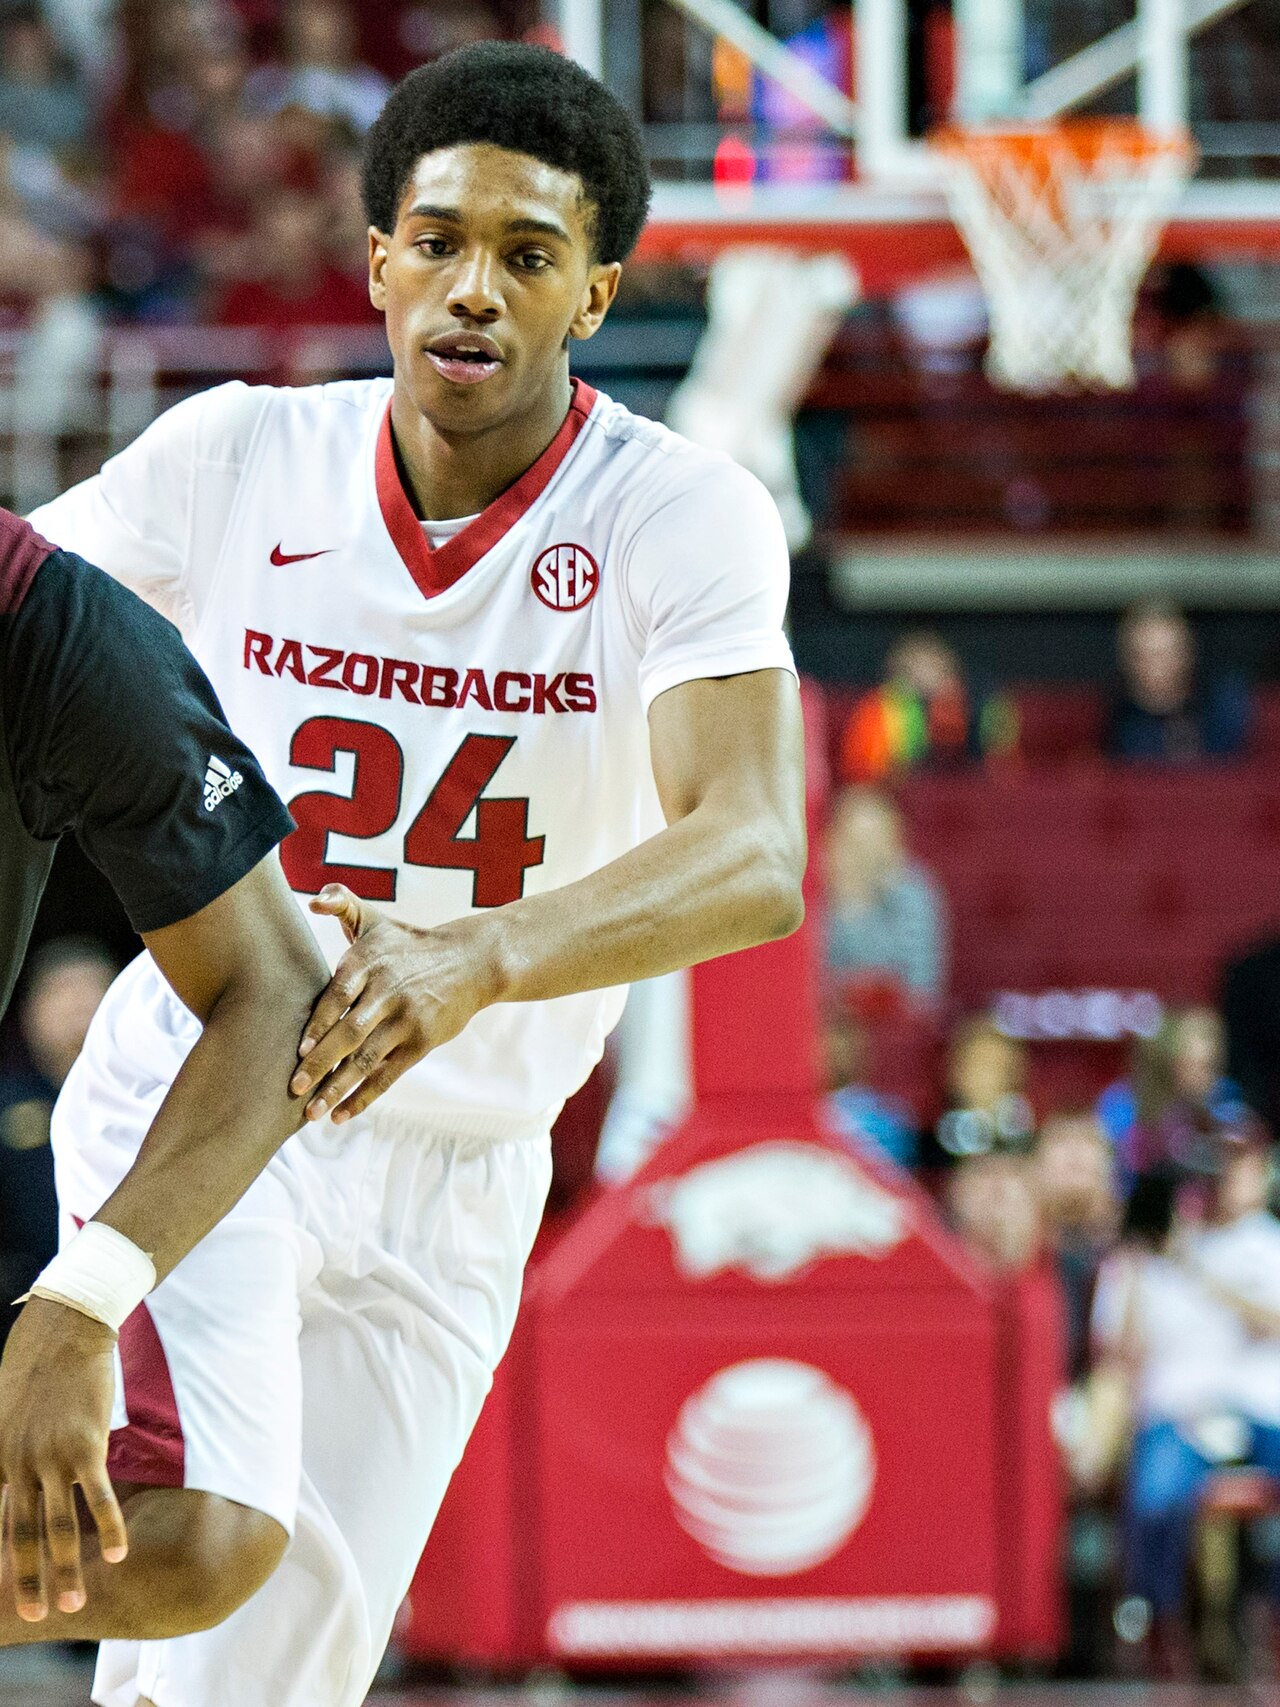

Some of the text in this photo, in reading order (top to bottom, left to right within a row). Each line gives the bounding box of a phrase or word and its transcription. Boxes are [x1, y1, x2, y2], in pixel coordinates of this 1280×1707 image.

[535, 546, 595, 608] SEC
[243, 627, 597, 715] RAZORBACKS
[204, 770, 244, 812] adidas
[278, 714, 547, 909] 24
